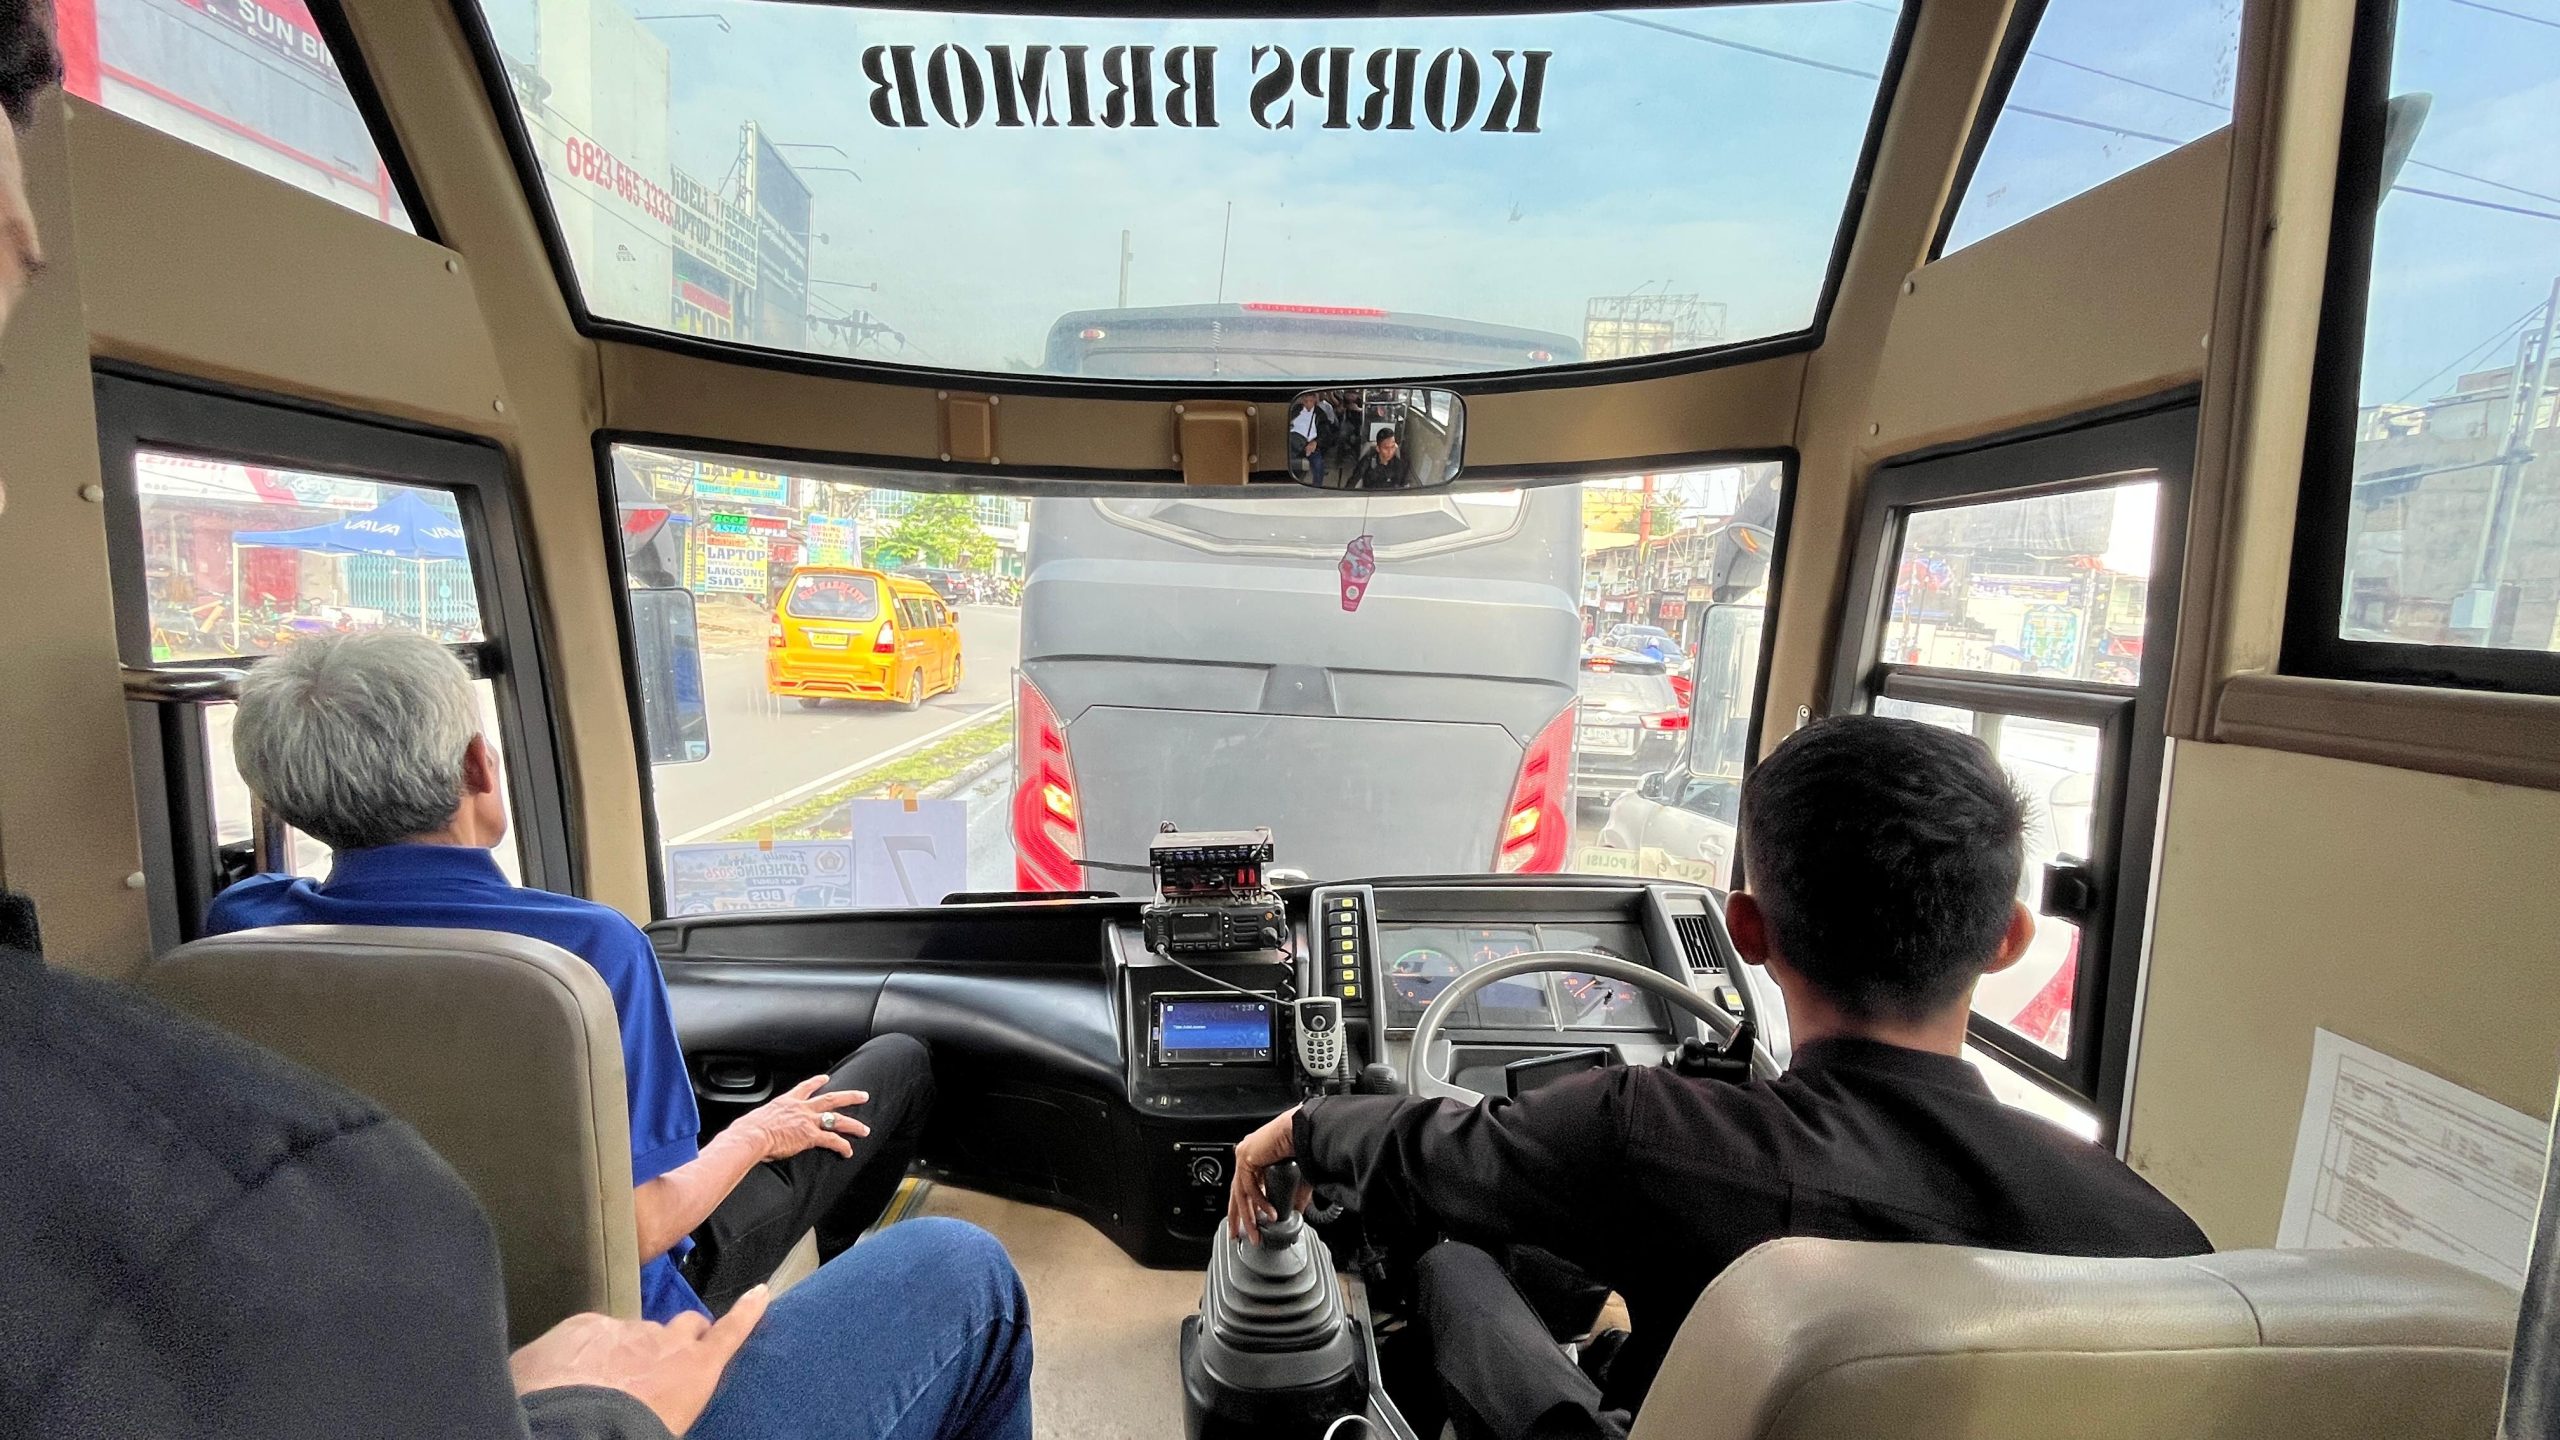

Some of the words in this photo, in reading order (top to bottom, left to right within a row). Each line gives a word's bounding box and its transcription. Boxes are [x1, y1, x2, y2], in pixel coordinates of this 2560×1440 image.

[238, 0, 293, 45] SUN
[566, 136, 612, 190] 0823
[616, 159, 641, 207] 665
[643, 178, 674, 226] 3333
[672, 298, 731, 337] PTOP
[707, 547, 765, 562] LAPTOP
[707, 566, 765, 577] LANGSUNG
